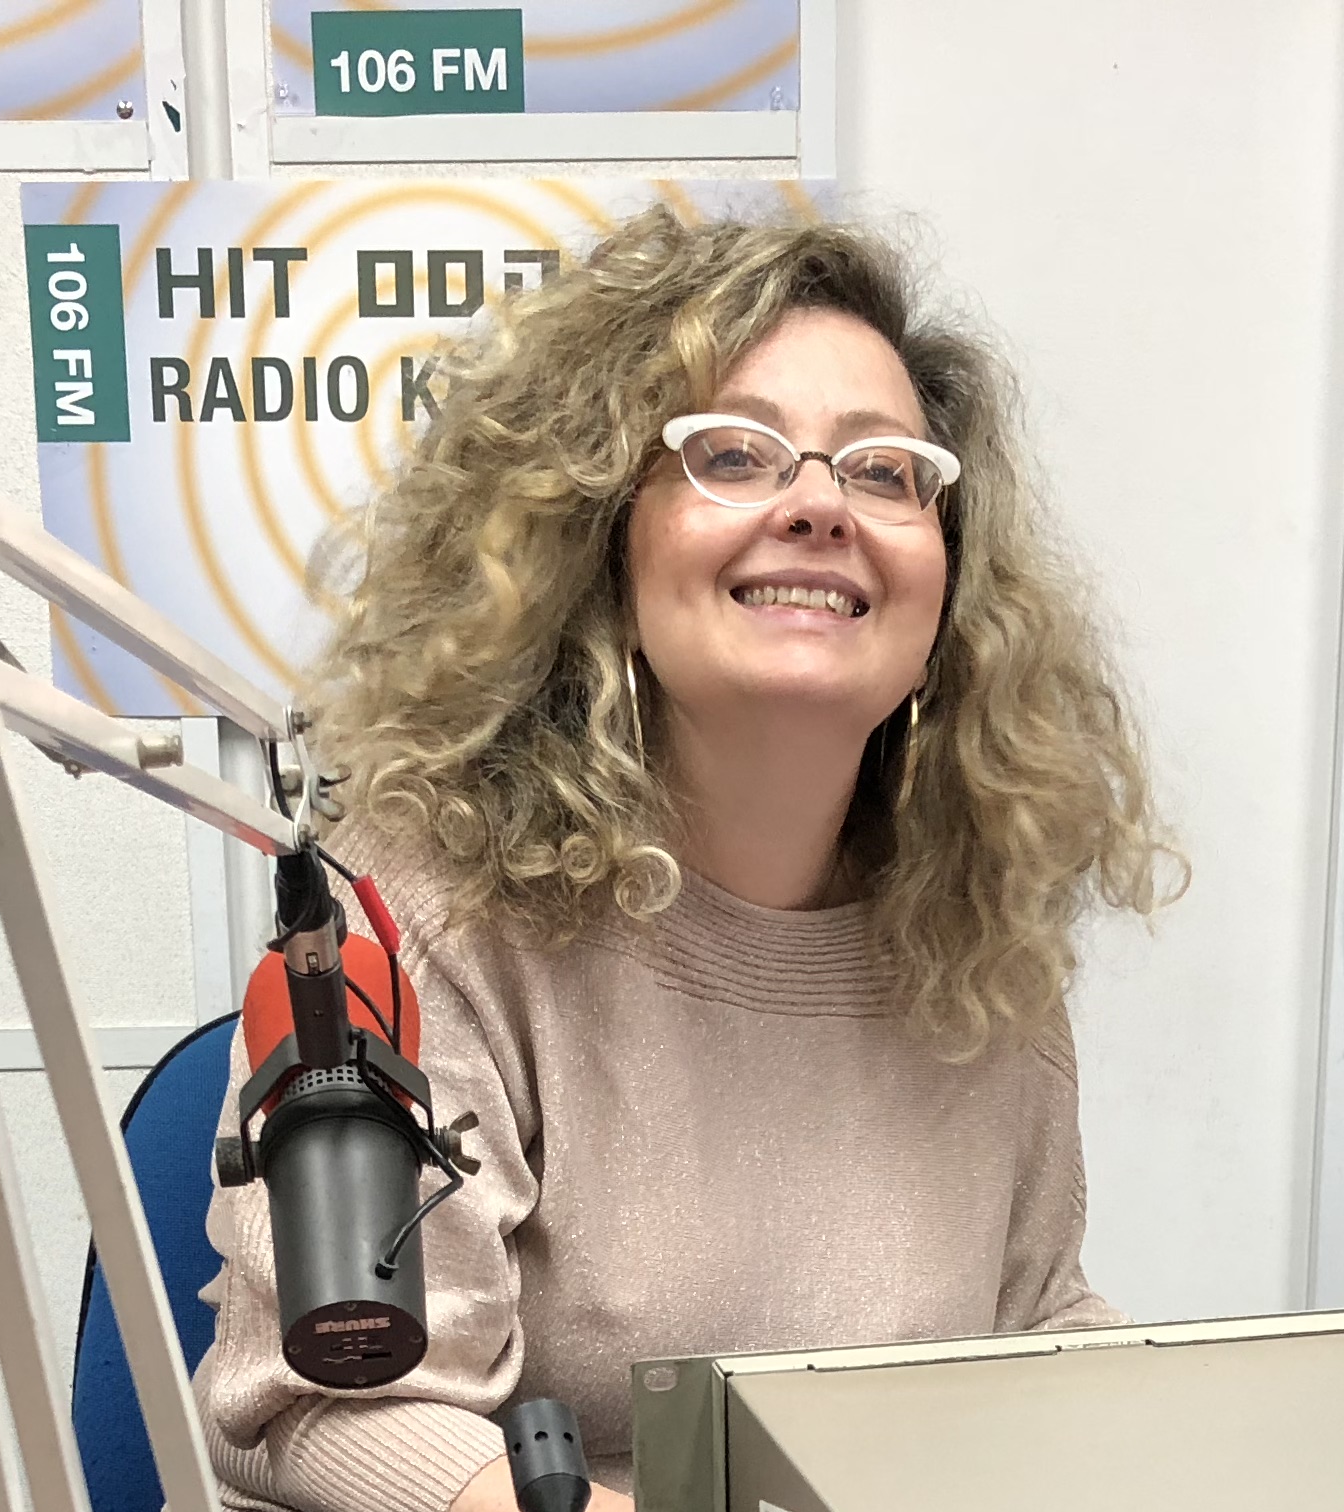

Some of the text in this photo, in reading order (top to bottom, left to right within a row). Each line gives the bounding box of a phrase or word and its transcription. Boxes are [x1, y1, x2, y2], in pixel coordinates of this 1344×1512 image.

[331, 49, 508, 92] 106 FM
[157, 248, 307, 318] HIT
[46, 242, 95, 426] 106 FM
[150, 355, 369, 423] RADIO
